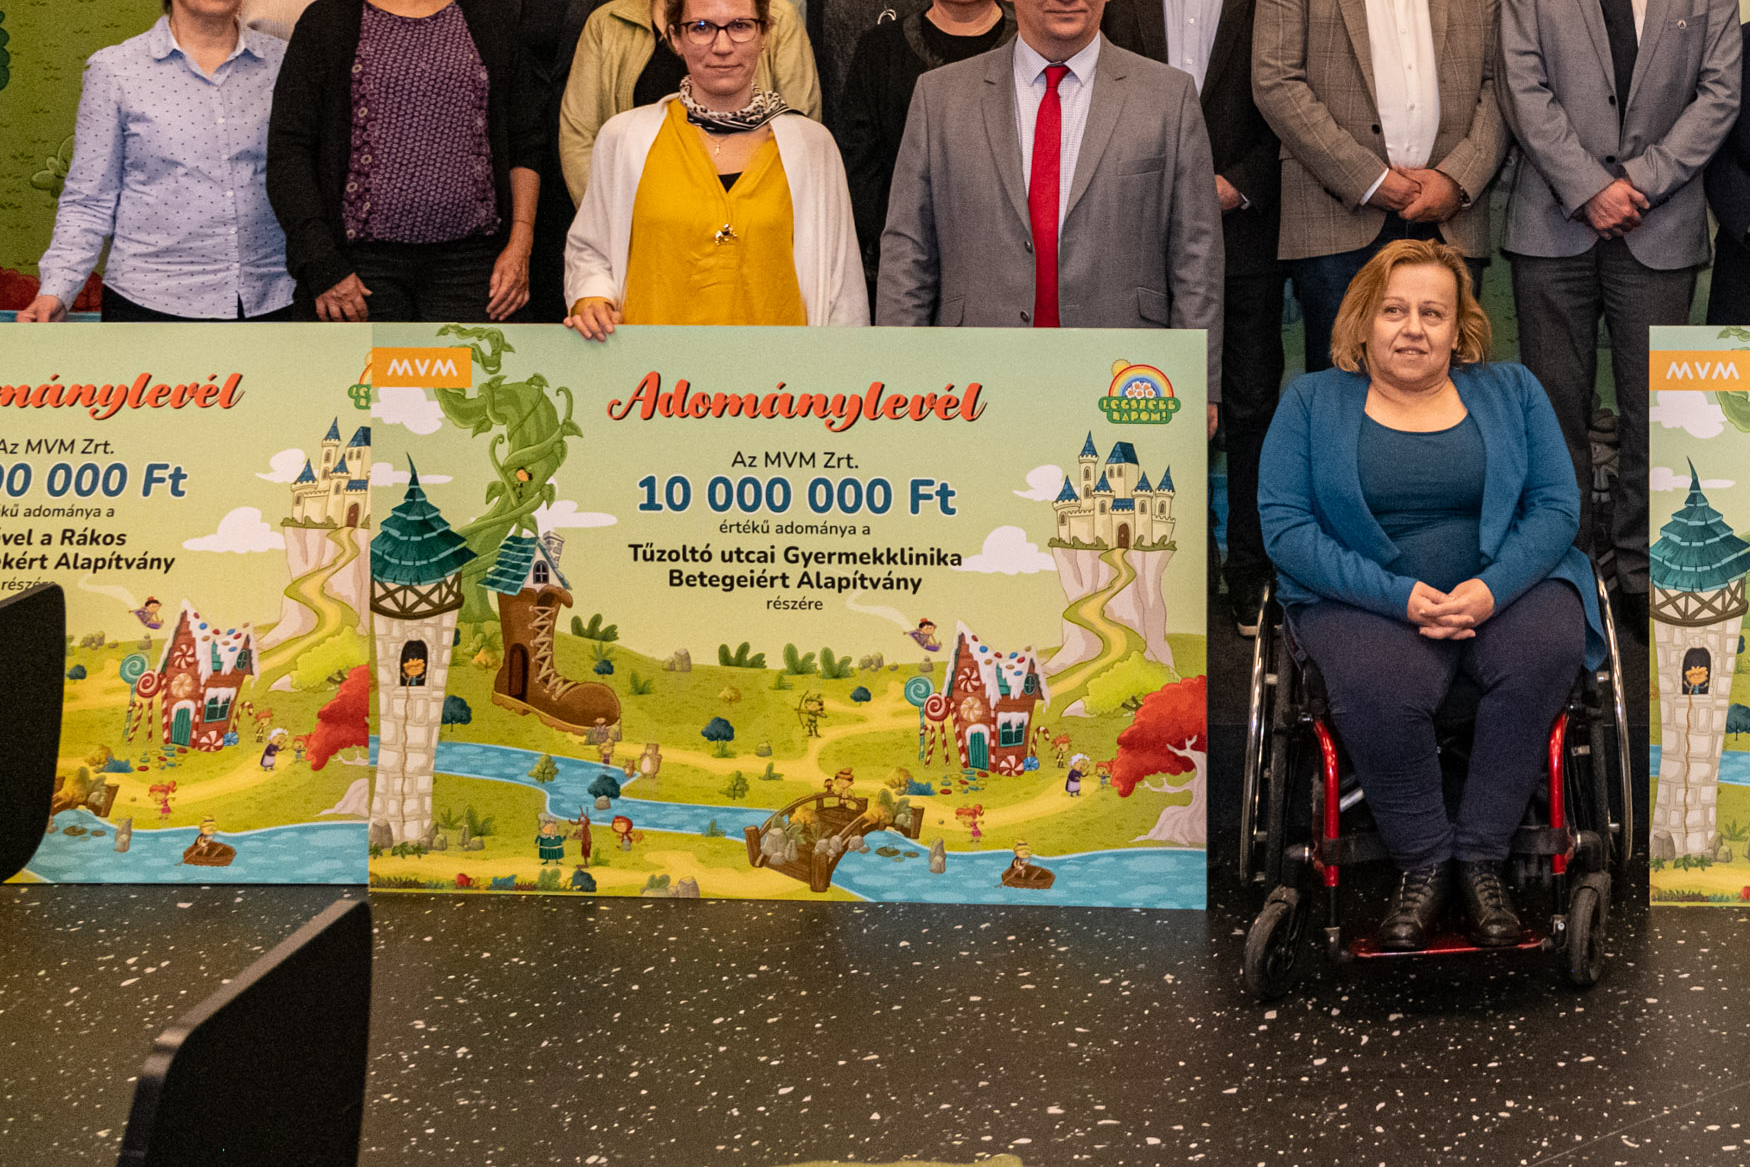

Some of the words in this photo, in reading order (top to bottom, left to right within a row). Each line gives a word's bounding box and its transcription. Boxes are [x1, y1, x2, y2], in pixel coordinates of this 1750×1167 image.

[387, 358, 458, 377] MVM
[1665, 361, 1740, 381] MVM
[606, 370, 989, 433] Adománylevél
[25, 439, 76, 455] MVM
[81, 439, 115, 455] Zrt.
[731, 451, 757, 468] Az
[764, 451, 816, 469] MVM
[823, 451, 860, 469] Zrt.
[0, 462, 32, 498] 0
[47, 462, 128, 498] 000
[143, 463, 189, 498] Ft
[638, 475, 692, 513] 10
[707, 476, 792, 514] 000
[808, 477, 893, 515] 000
[910, 479, 957, 516] Ft
[23, 504, 102, 520] adománya
[106, 508, 115, 518] a
[40, 533, 53, 546] a
[60, 526, 127, 546] Rákos
[719, 518, 770, 535] értékű
[775, 520, 857, 538] adománya
[861, 526, 871, 536] a
[54, 550, 176, 575] Alapítvány
[628, 543, 713, 563] Tűzoltó
[720, 545, 776, 564] utcai
[783, 546, 963, 568] Gyermekklinika
[1, 576, 56, 592] részé
[668, 569, 790, 592] Betegeiért
[796, 570, 923, 595] Alapítvány
[766, 595, 824, 611] részére
